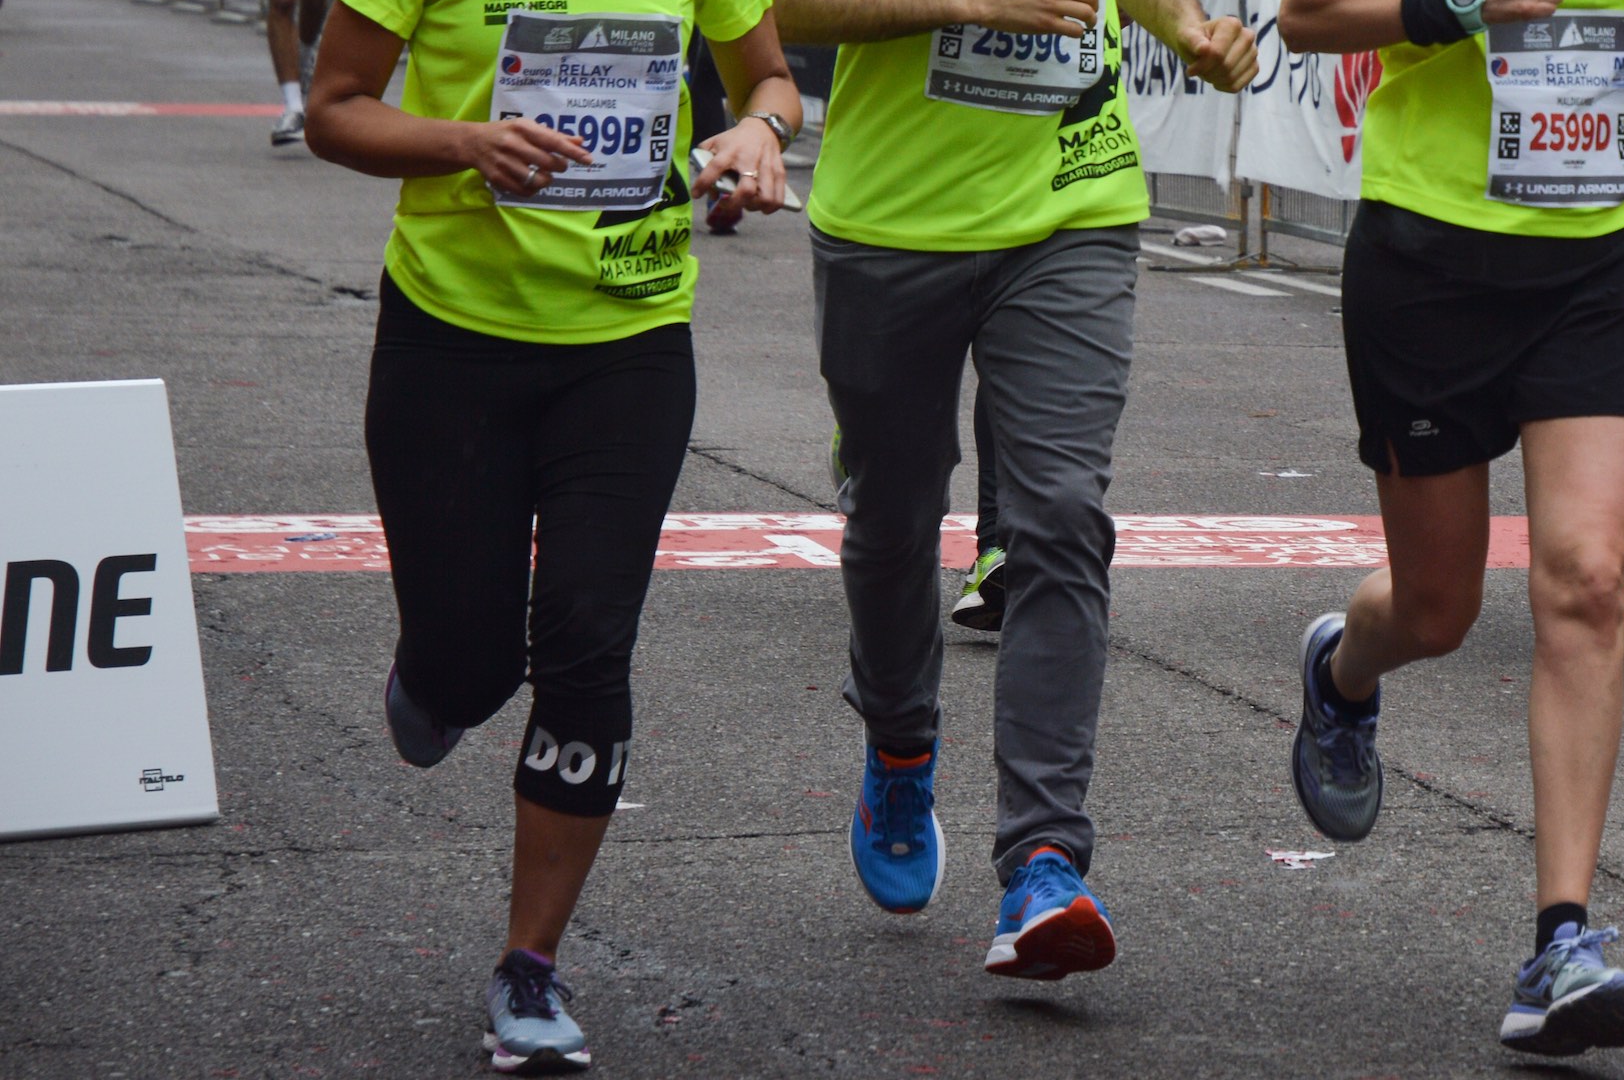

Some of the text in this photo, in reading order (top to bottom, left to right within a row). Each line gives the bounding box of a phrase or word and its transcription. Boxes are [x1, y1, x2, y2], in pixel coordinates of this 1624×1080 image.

[484, 0, 568, 13] MARIO NEGRI
[610, 30, 655, 42] MILANO
[1583, 26, 1616, 37] MILANO
[971, 26, 1071, 64] 2599C
[522, 69, 552, 78] europ
[559, 64, 613, 76] RELAY
[1511, 67, 1539, 78] europ
[1546, 63, 1588, 75] RELAY
[499, 76, 551, 86] assistance
[557, 77, 637, 89] MARATHON
[1546, 76, 1609, 87] MARATHON
[964, 84, 1018, 101] UNDER
[1529, 112, 1612, 152] 2599D
[538, 187, 586, 198] NDER
[1526, 183, 1575, 195] UNDER
[600, 228, 690, 261] MILANO
[600, 248, 682, 280] MARATHON
[524, 725, 597, 785] DO
